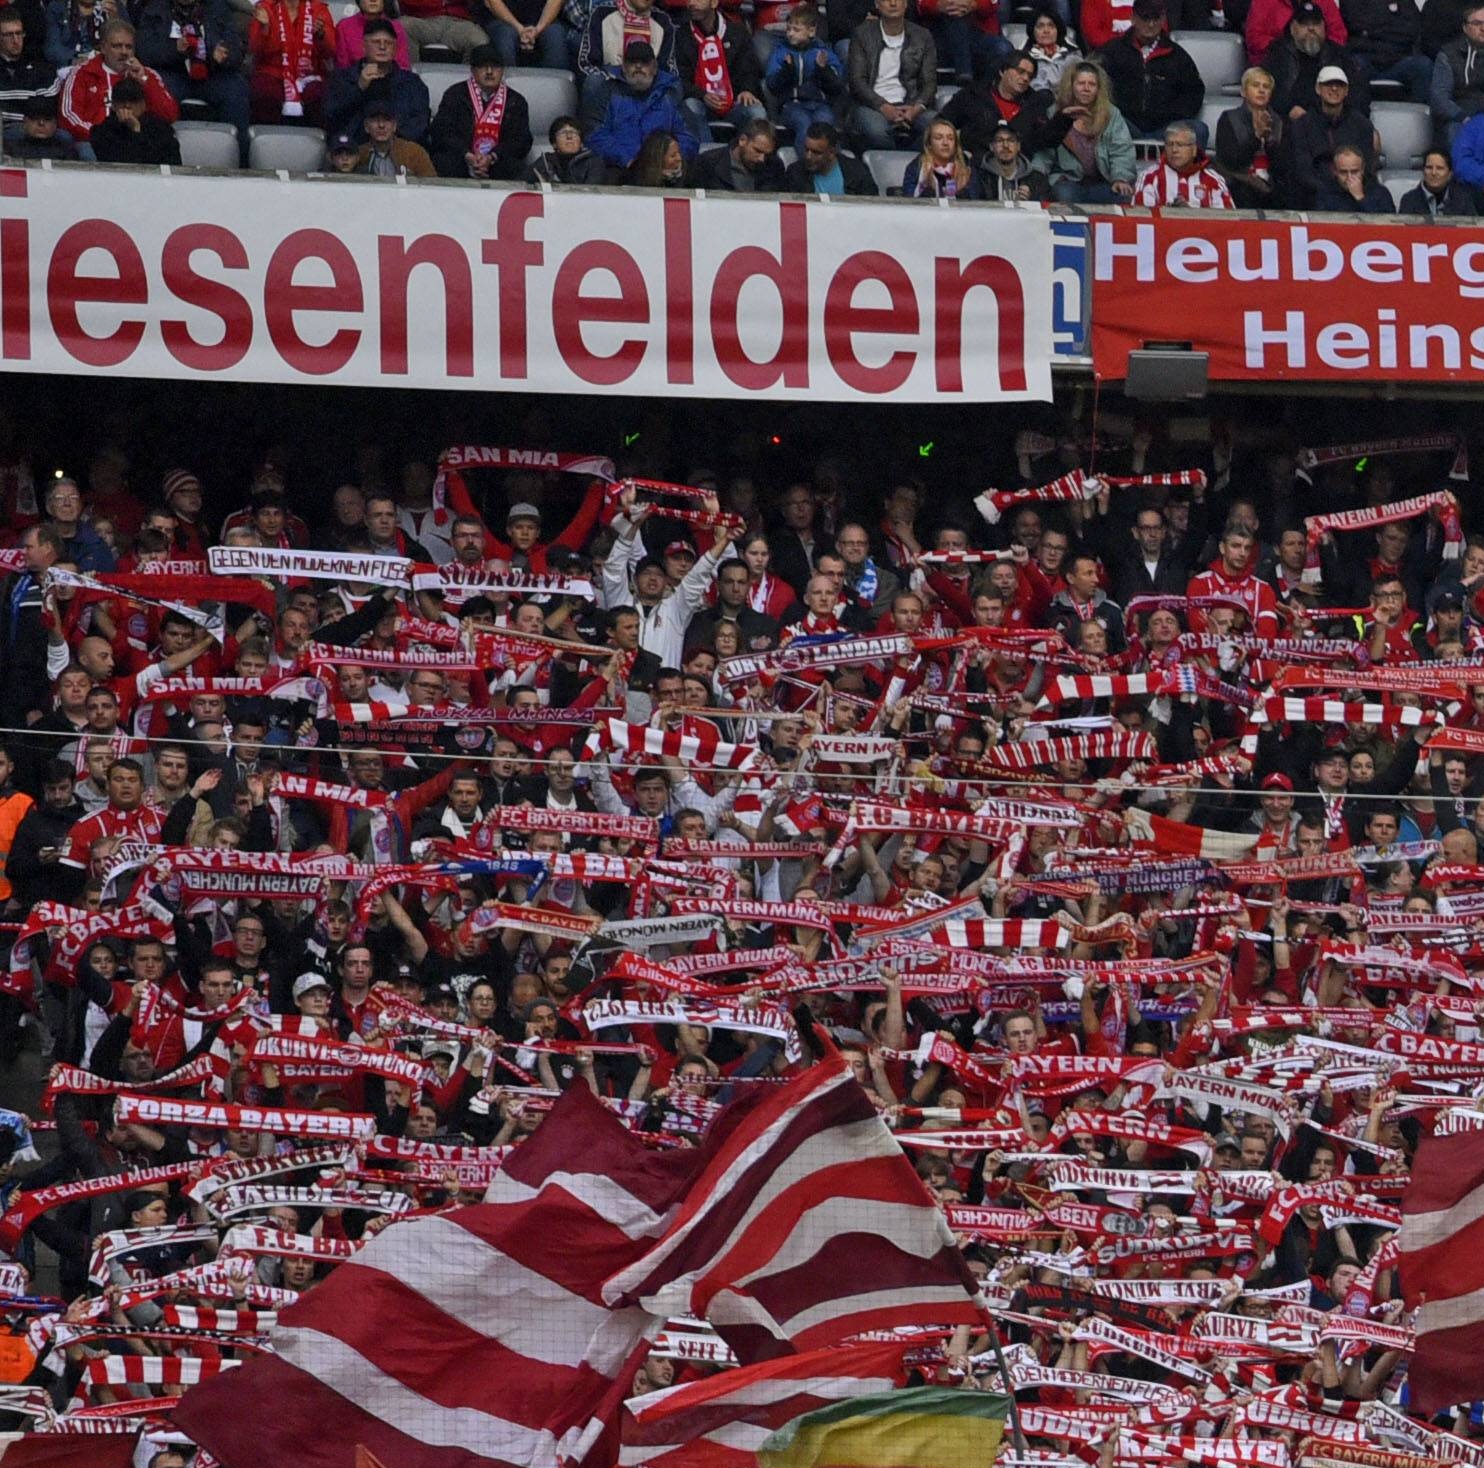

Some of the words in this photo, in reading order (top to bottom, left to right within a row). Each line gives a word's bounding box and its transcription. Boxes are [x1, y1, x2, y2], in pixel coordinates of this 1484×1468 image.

[447, 446, 501, 466] SAN
[507, 448, 560, 467] MIA
[153, 675, 200, 693] SAN
[205, 675, 263, 693] MIA
[121, 1097, 217, 1126] FORZA
[239, 1105, 374, 1136] BAYERN
